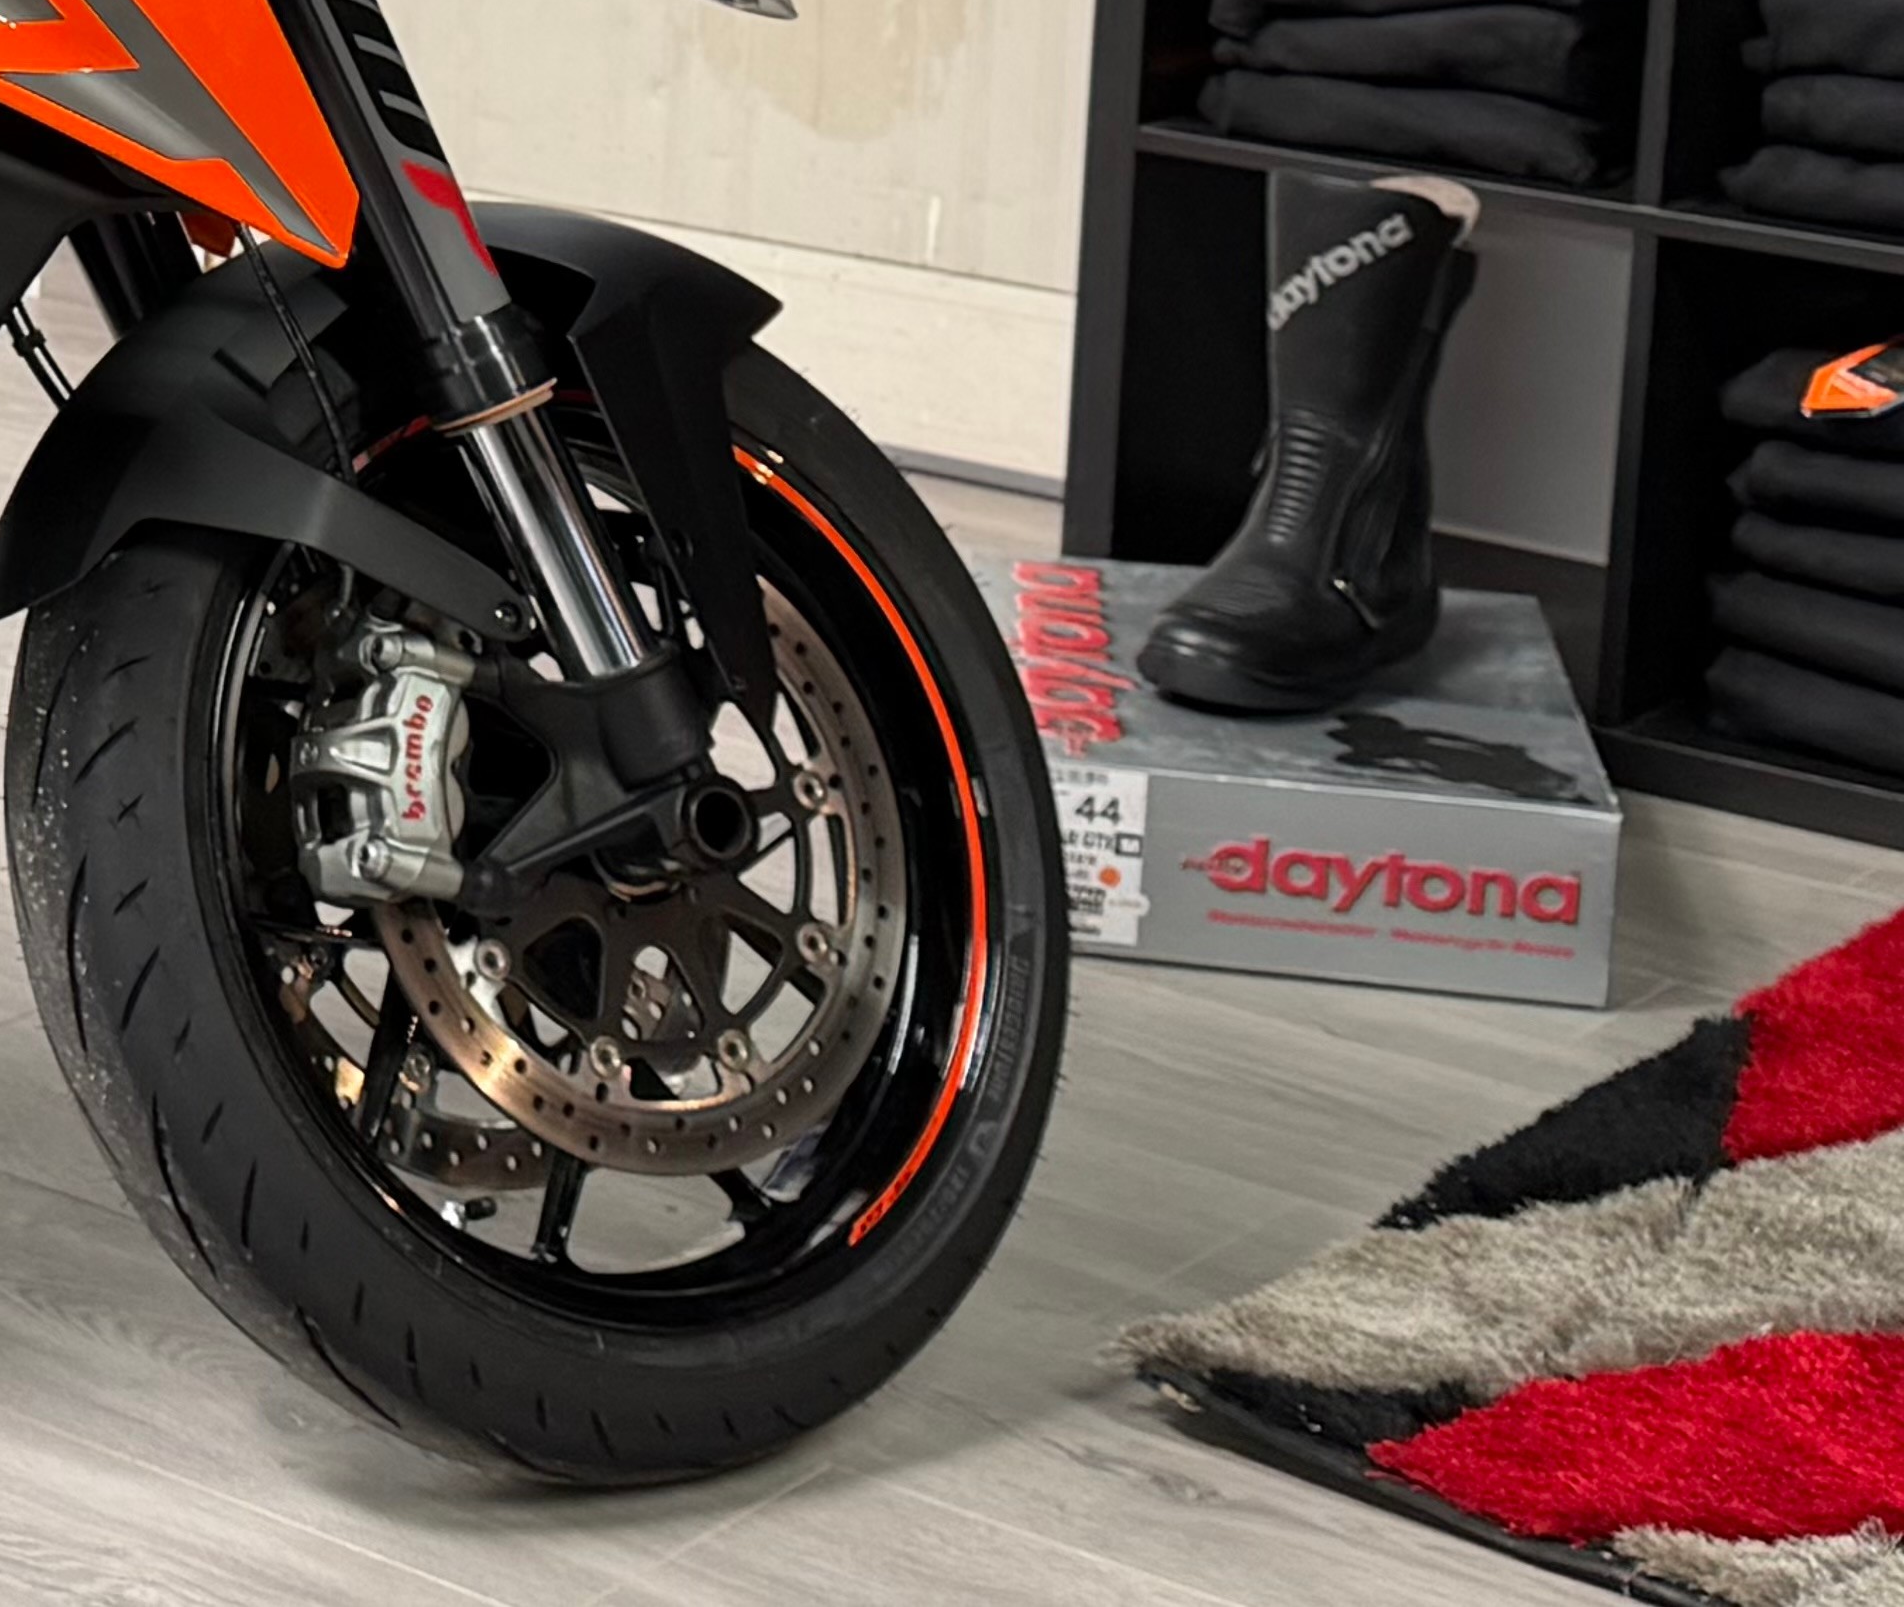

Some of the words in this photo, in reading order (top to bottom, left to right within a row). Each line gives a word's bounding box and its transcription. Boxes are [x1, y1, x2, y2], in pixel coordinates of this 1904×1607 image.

[1266, 212, 1414, 332] daytona
[401, 694, 435, 823] brembo
[1074, 795, 1122, 825] 44
[1206, 834, 1582, 926] daytona
